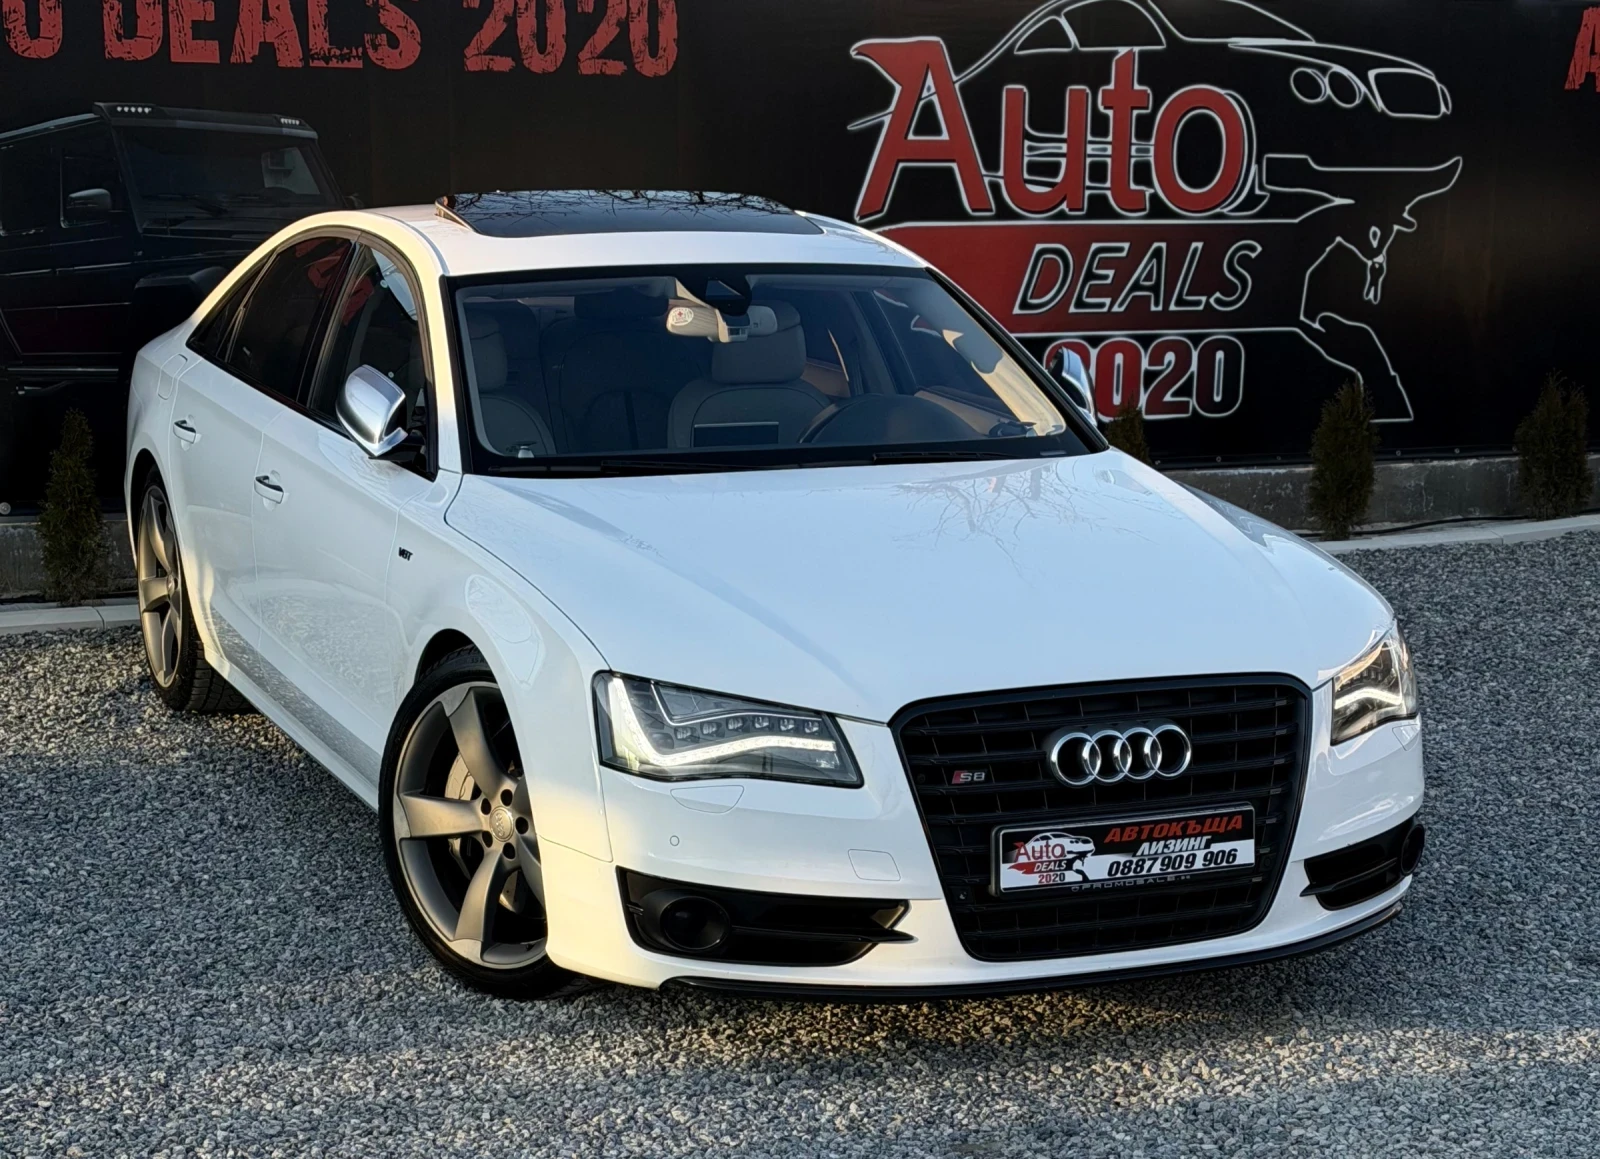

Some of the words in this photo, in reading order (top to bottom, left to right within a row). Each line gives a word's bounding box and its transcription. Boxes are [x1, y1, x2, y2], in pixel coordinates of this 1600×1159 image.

[103, 0, 421, 70] DEALS
[462, 0, 678, 77] 2020
[850, 35, 1254, 222] Auto
[1012, 240, 1263, 315] DEALS
[960, 772, 985, 782] S8
[1103, 814, 1243, 844] АВТОКЪЩА
[1013, 840, 1067, 863] Auto
[1135, 835, 1212, 857] ЛИЗИНГ
[1034, 860, 1067, 873] DEALS
[1107, 855, 1157, 878] 0887
[1159, 853, 1198, 873] 909
[1201, 848, 1239, 868] 906
[1038, 872, 1066, 884] 2020
